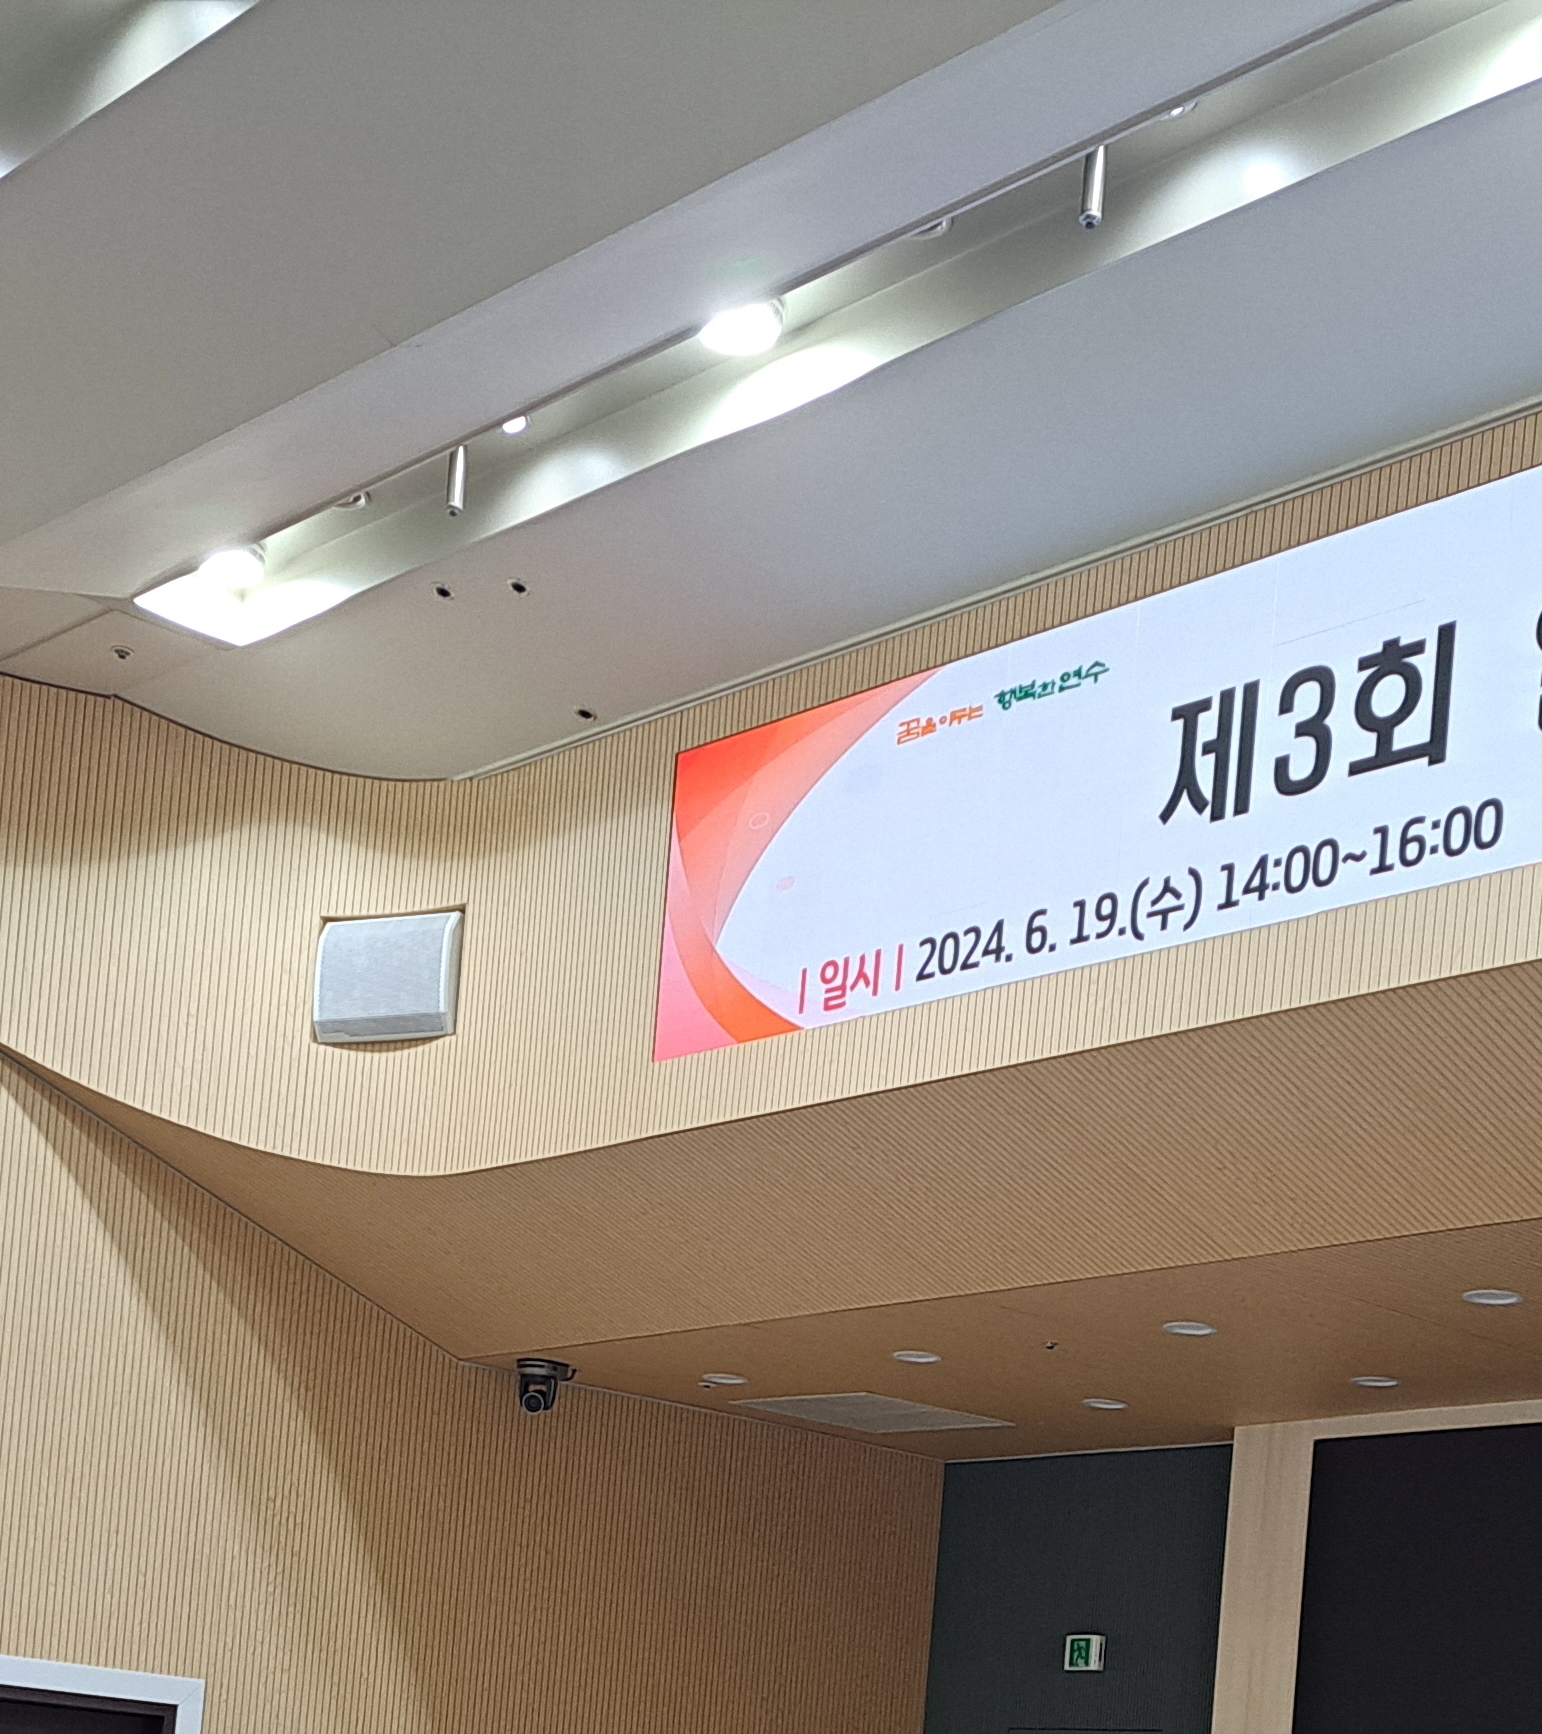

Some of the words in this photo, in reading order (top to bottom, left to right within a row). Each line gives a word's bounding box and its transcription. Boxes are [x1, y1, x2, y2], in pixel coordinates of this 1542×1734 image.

[1159, 621, 1457, 826] 제3회
[819, 949, 882, 1013] 일시
[915, 919, 1015, 983] 2024.
[1025, 909, 1058, 956] 6.
[1069, 866, 1203, 945] 19.(수)
[1217, 797, 1505, 911] 14:00~16:00
